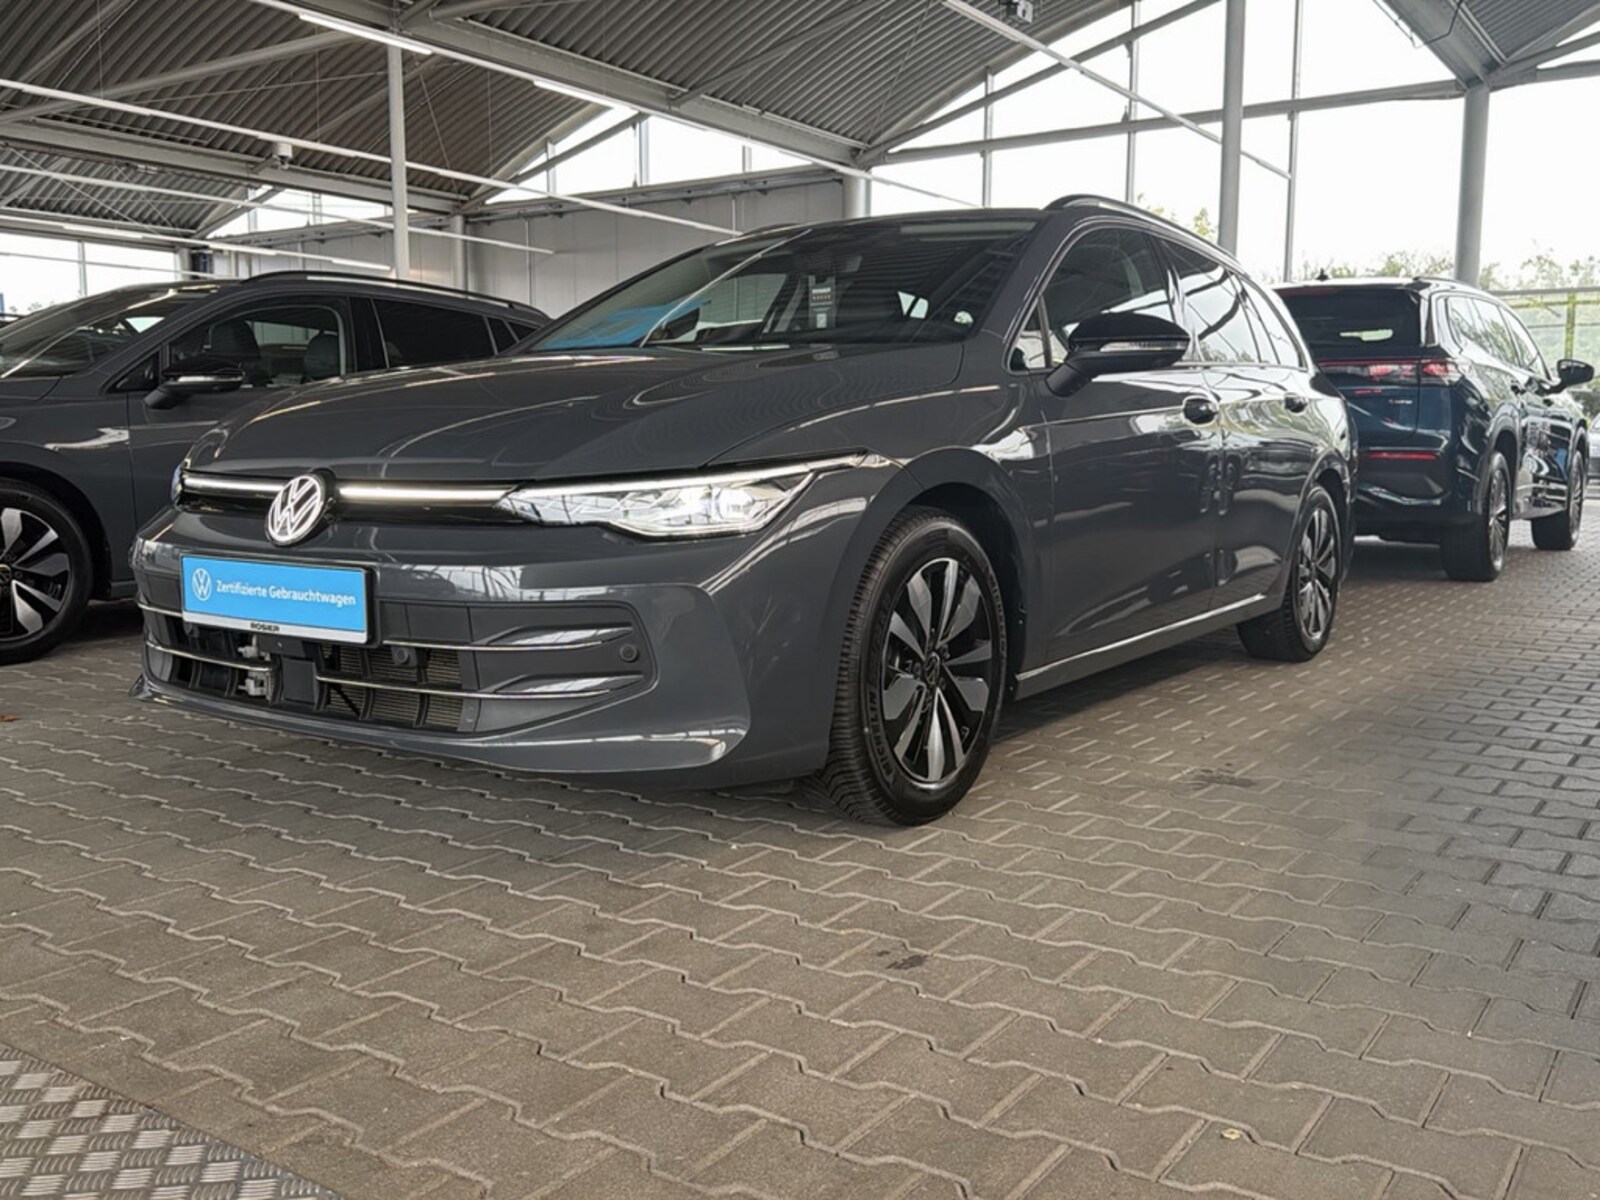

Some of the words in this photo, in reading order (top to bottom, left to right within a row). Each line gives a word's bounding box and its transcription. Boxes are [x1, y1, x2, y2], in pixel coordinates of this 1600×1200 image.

[267, 475, 322, 543] VW
[192, 567, 211, 601] VW
[216, 580, 267, 597] Zertifizierte
[268, 585, 356, 607] Gebrauchtwagen
[868, 689, 894, 777] MICHELIN
